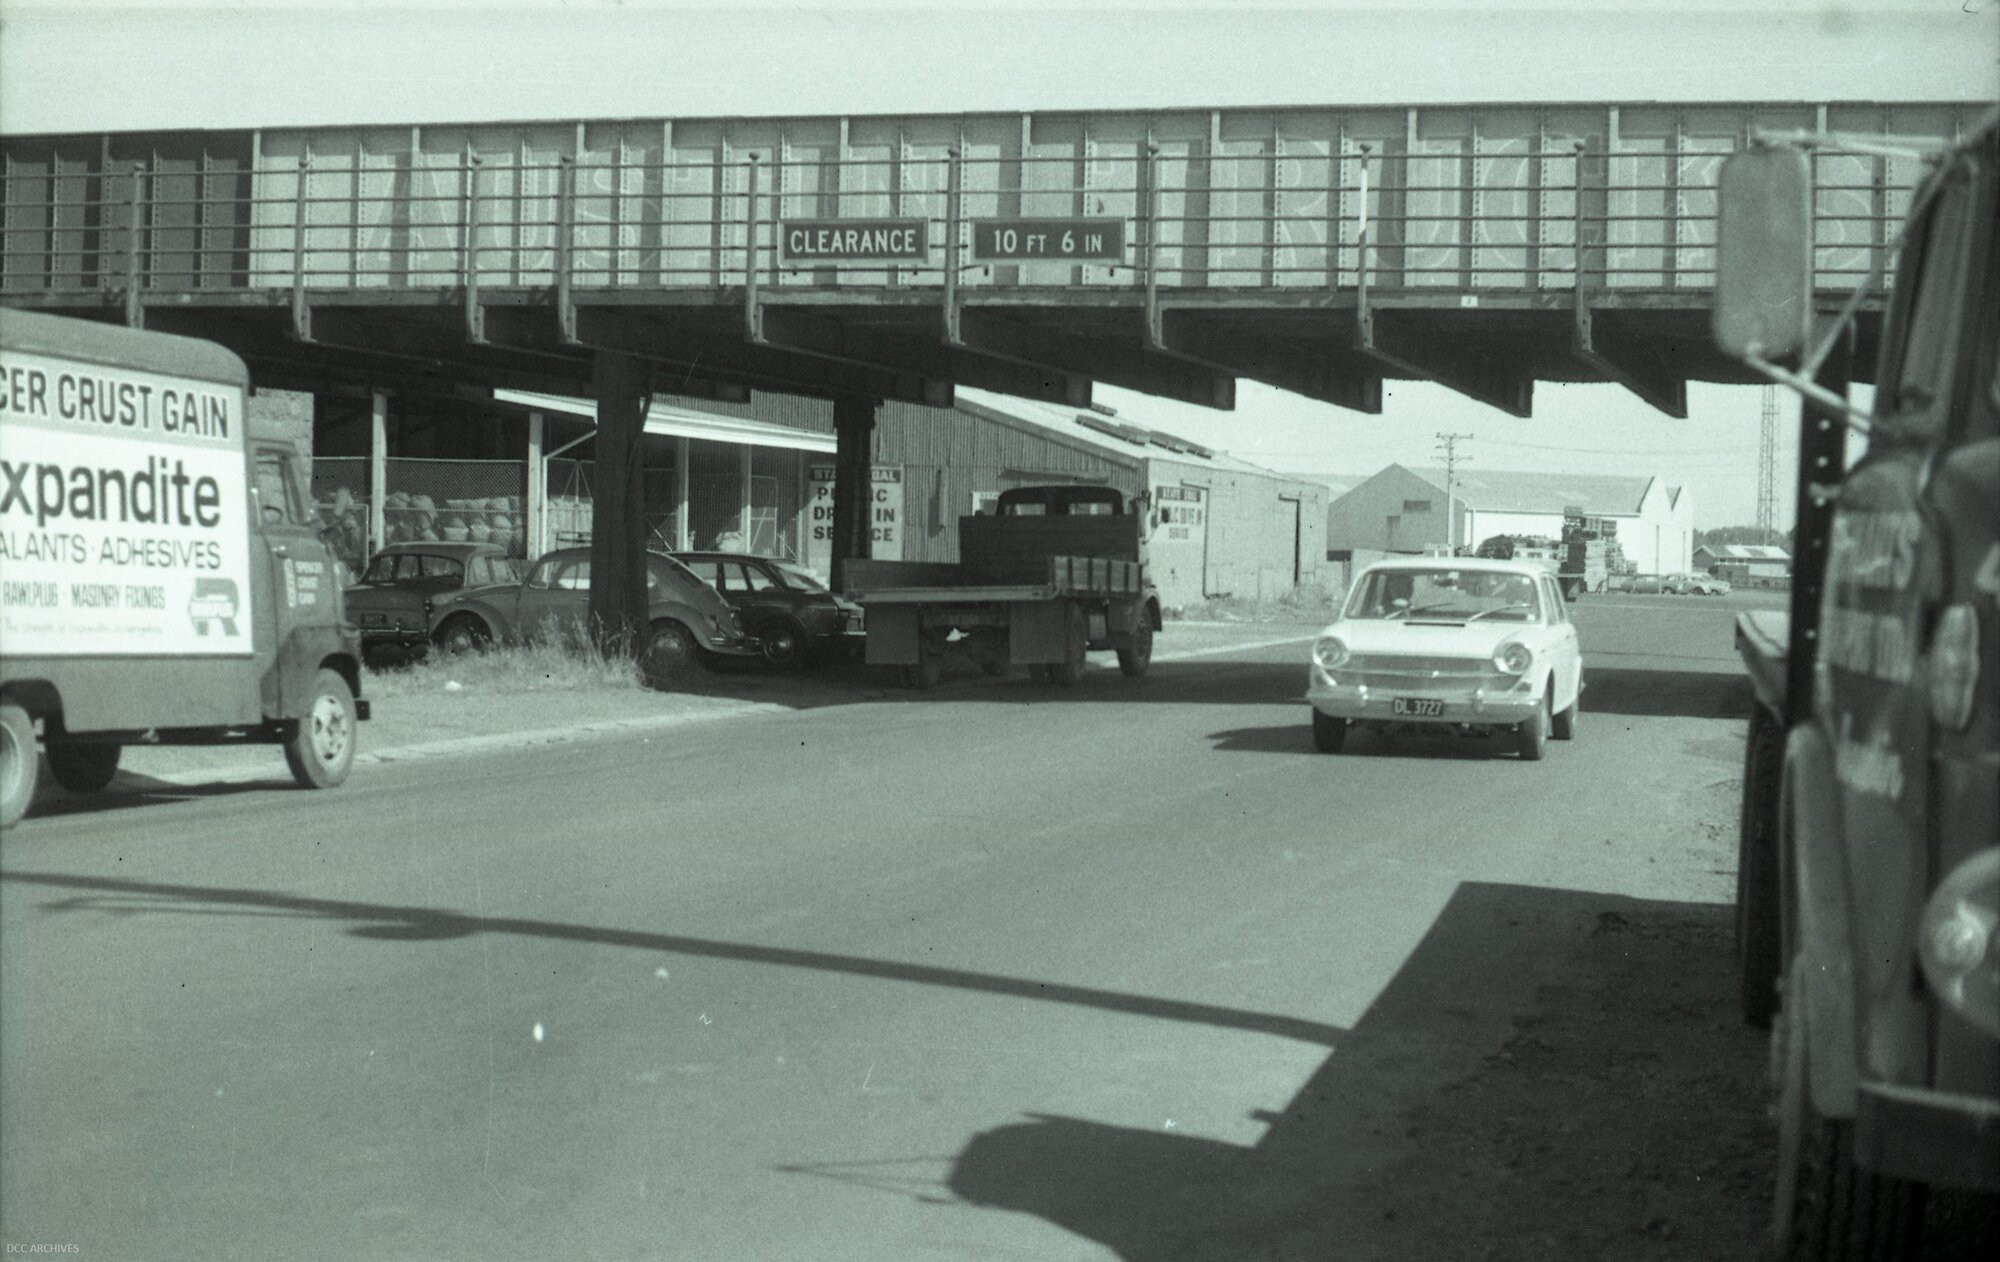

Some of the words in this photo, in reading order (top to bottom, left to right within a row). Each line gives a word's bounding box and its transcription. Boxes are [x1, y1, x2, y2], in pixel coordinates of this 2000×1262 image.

[790, 229, 917, 254] CLEARANCE
[994, 230, 1017, 253] 10
[1026, 234, 1048, 252] FT
[1060, 230, 1076, 253] 6
[1084, 234, 1103, 253] IN
[58, 373, 153, 429] CRUST
[162, 389, 229, 438] GAIN
[871, 469, 897, 482] OAL
[0, 455, 221, 528] xpandite
[99, 536, 221, 569] ADHESIVES
[71, 583, 121, 608] MASONRY
[125, 584, 166, 609] FIXINGS
[1394, 699, 1411, 714] DL
[1414, 700, 1442, 715] 3727
